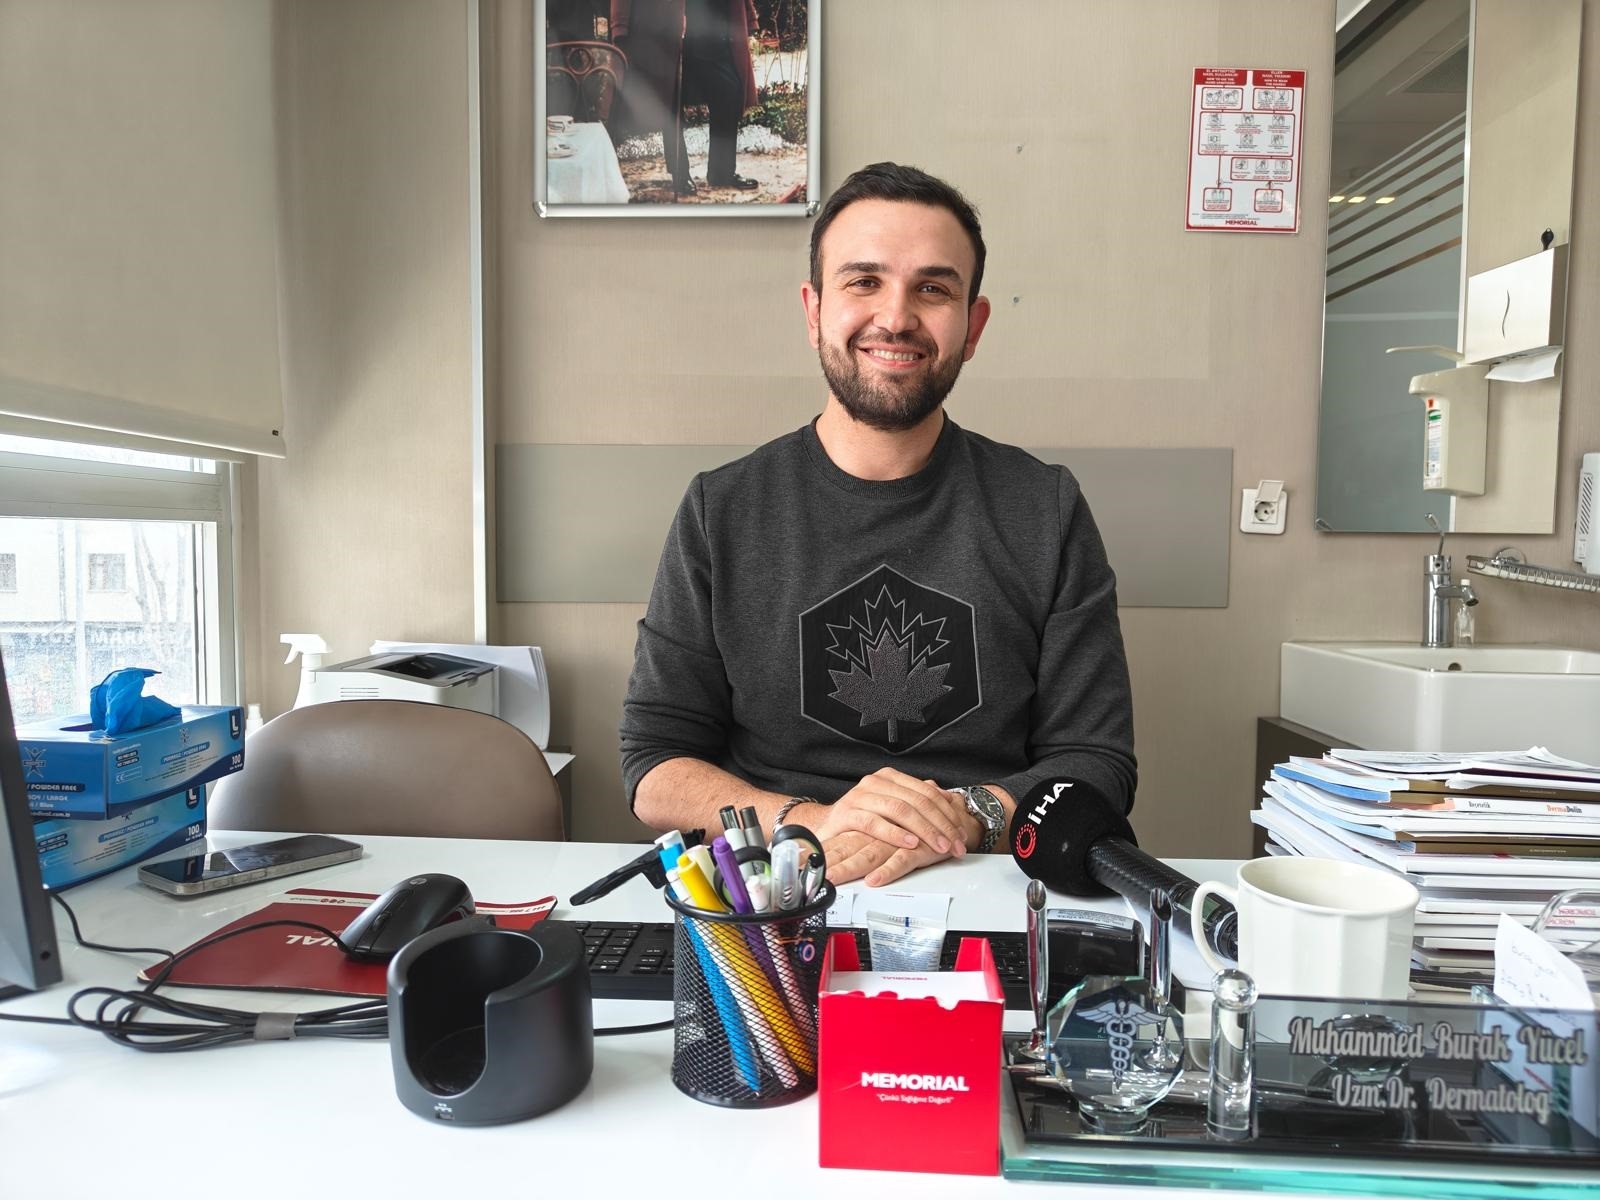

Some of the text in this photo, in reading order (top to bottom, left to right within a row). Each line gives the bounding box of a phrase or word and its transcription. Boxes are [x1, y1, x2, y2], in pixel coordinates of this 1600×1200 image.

[232, 715, 240, 732] L
[232, 754, 242, 766] 100
[188, 824, 200, 834] 100
[1289, 1016, 1588, 1064] Muhammed Burak Yücel
[862, 1072, 970, 1092] MEMORIAL
[1425, 1076, 1551, 1125] Dermatolog
